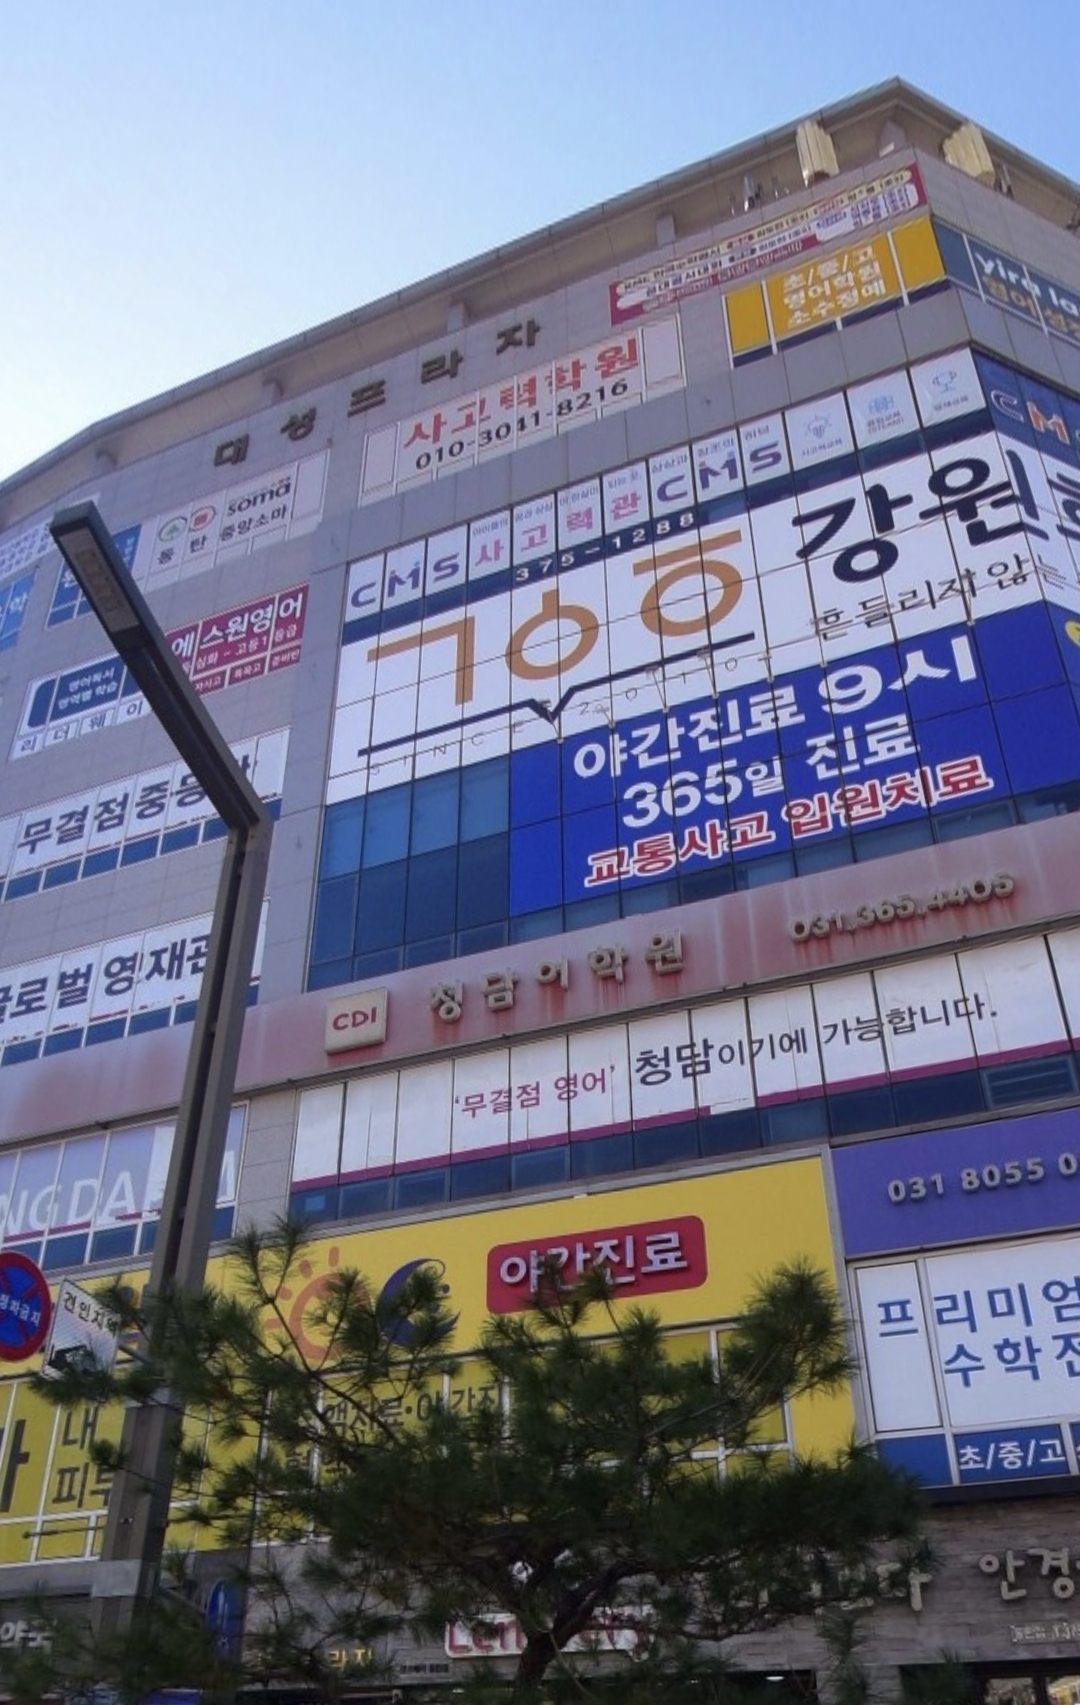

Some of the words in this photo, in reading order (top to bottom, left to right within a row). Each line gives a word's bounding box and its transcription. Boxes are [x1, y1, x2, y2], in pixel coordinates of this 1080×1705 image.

[402, 336, 640, 449] 사고력학원
[415, 376, 629, 470] 010-3041-8216
[990, 389, 1080, 446] CM
[227, 482, 291, 517] soma
[350, 551, 461, 609] CMS
[656, 440, 784, 504] CMS
[515, 511, 695, 584] 375-1288
[573, 682, 806, 781] 야간진료
[815, 634, 978, 715] 9시
[622, 754, 785, 829] 365일
[806, 712, 922, 781] 진료
[584, 810, 777, 889] 교통사고
[780, 752, 996, 840] 입원치료
[332, 1006, 378, 1032] CDI
[430, 926, 686, 1024] 청담어학원
[634, 1026, 809, 1088] 청담이기에
[822, 992, 999, 1047] 가능합니다.
[888, 1173, 945, 1203] 031
[960, 1157, 1045, 1193] 8055
[959, 1438, 1066, 1471] 초/중/고
[978, 1546, 1080, 1601] 안경
